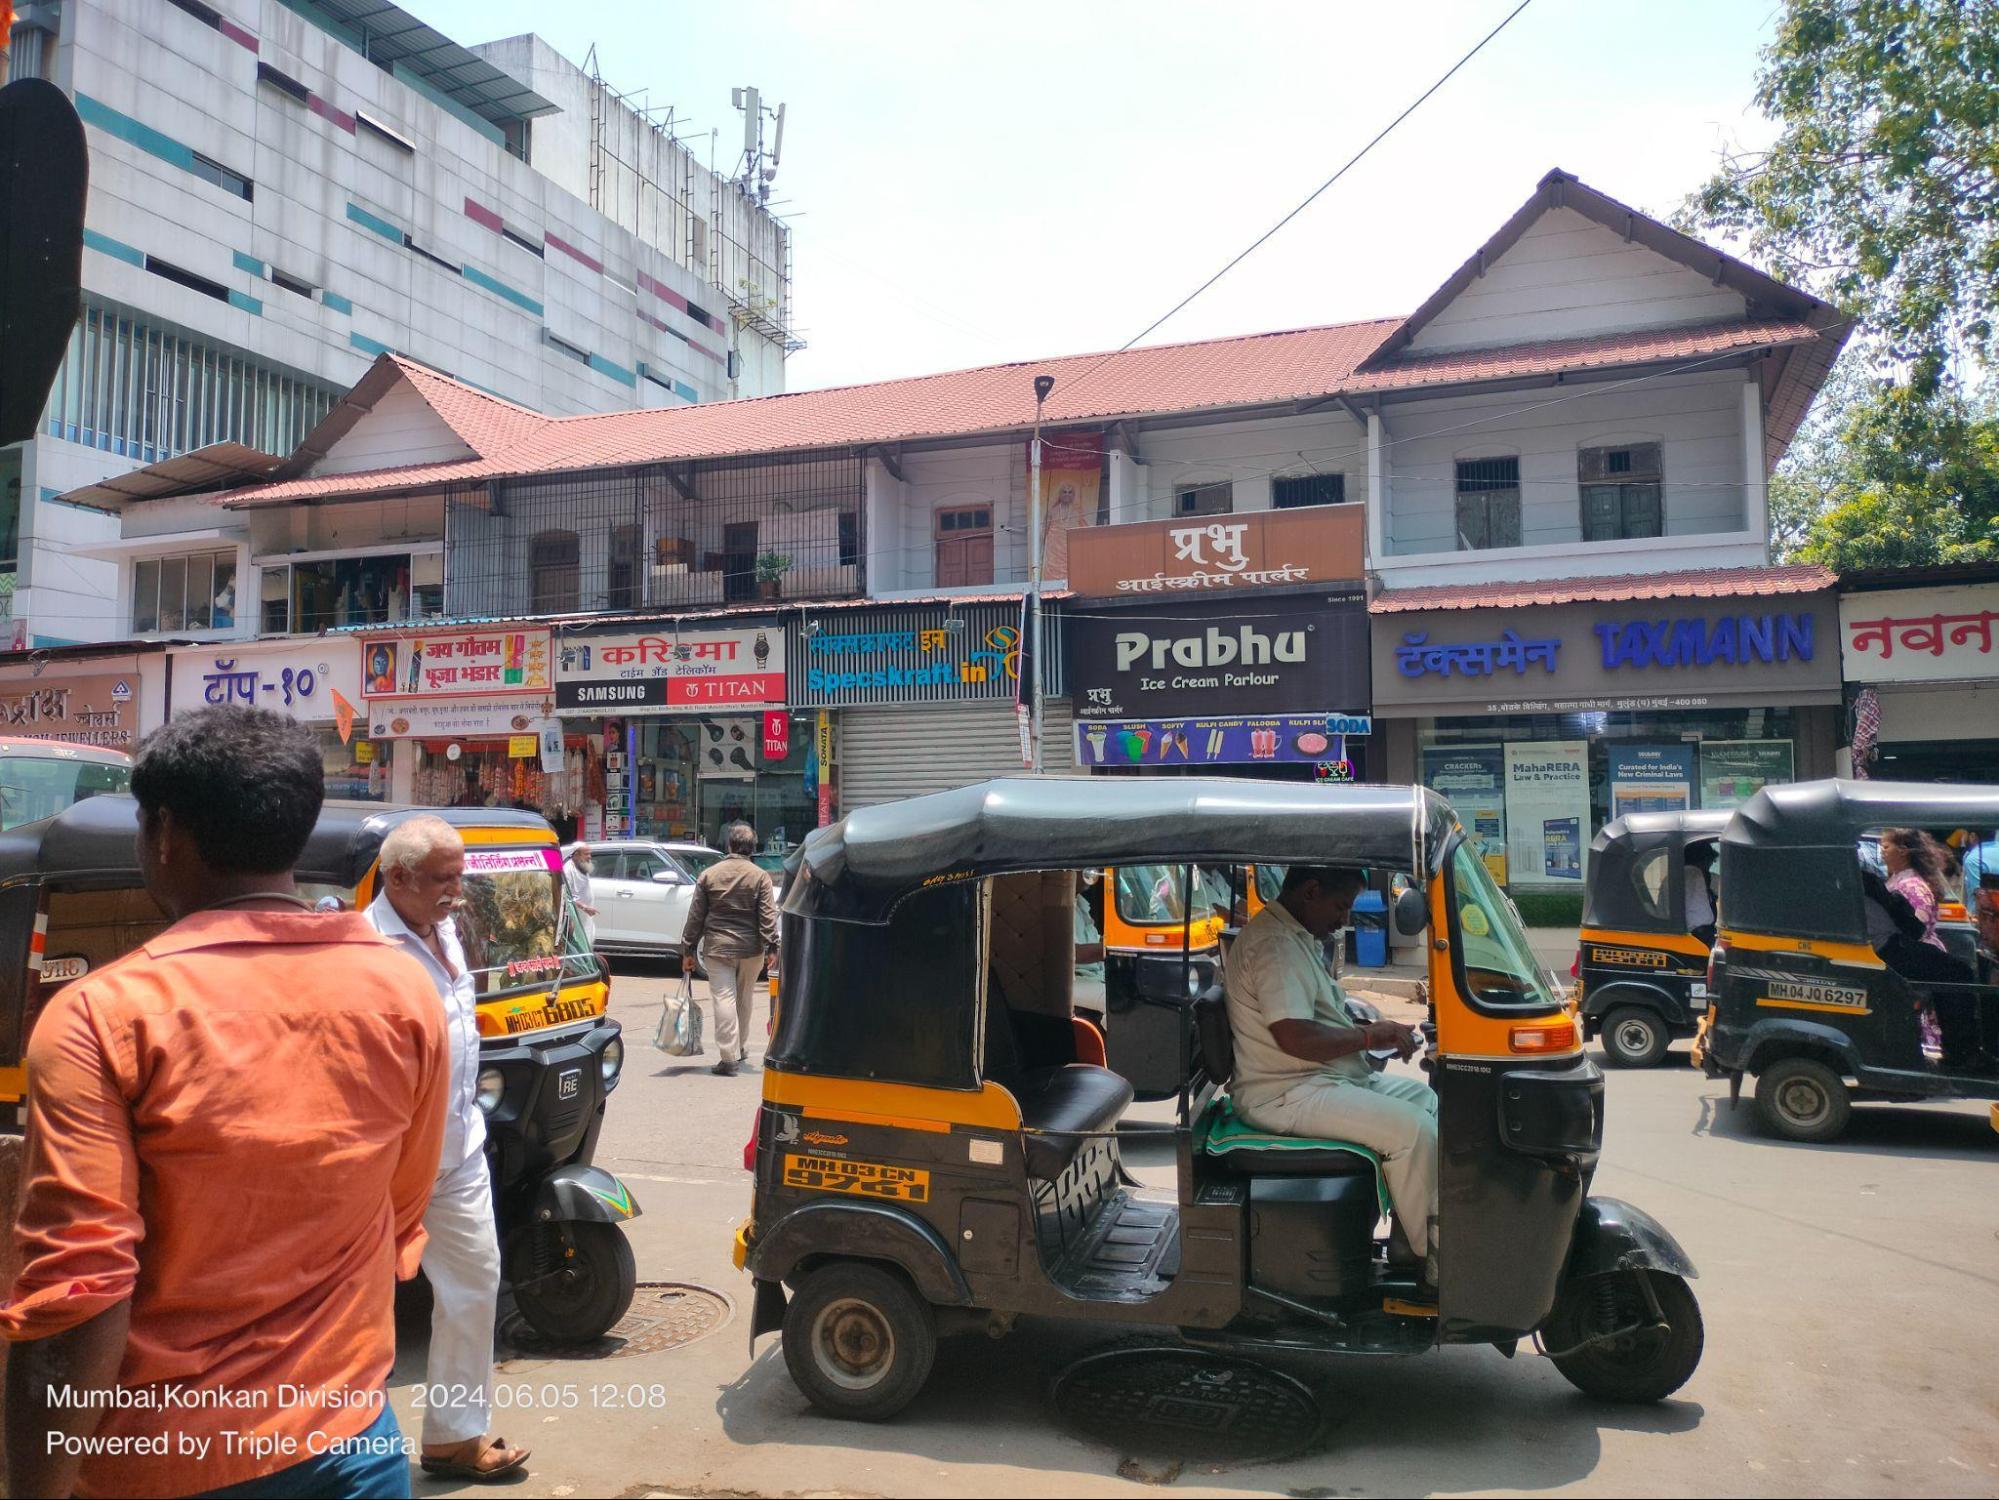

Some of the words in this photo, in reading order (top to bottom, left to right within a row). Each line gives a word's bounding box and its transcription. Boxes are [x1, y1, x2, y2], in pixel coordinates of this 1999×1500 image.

[1170, 523, 1249, 570] प्रभु
[1116, 571, 1233, 592] आईस्क्रीम
[1239, 564, 1309, 583] पार्लर
[426, 642, 452, 658] जय
[457, 636, 502, 657] गौतम
[919, 628, 945, 653] इन
[1115, 625, 1306, 671] Prabhu
[1594, 613, 1814, 668] TAXMANN
[425, 668, 457, 688] पूजा
[461, 665, 502, 682] भंडार
[675, 662, 717, 675] टेलिकॉम
[808, 661, 987, 694] Specskraft.in
[1141, 677, 1167, 690] Ice
[1171, 675, 1219, 689] Cream
[1225, 672, 1279, 687] Parlour
[577, 685, 646, 702] SAMSUNG
[705, 681, 766, 697] TITAN
[1123, 722, 1146, 730] SLUSH
[1218, 720, 1244, 728] CANDY
[1326, 718, 1370, 734] SODA
[765, 739, 788, 752] TITAN
[820, 727, 828, 767] SONATA
[1513, 762, 1581, 773] MahaRERA
[1543, 773, 1581, 781] Practice
[1824, 989, 1864, 1006] 6297
[542, 997, 597, 1025] 6805
[563, 1078, 578, 1094] RE
